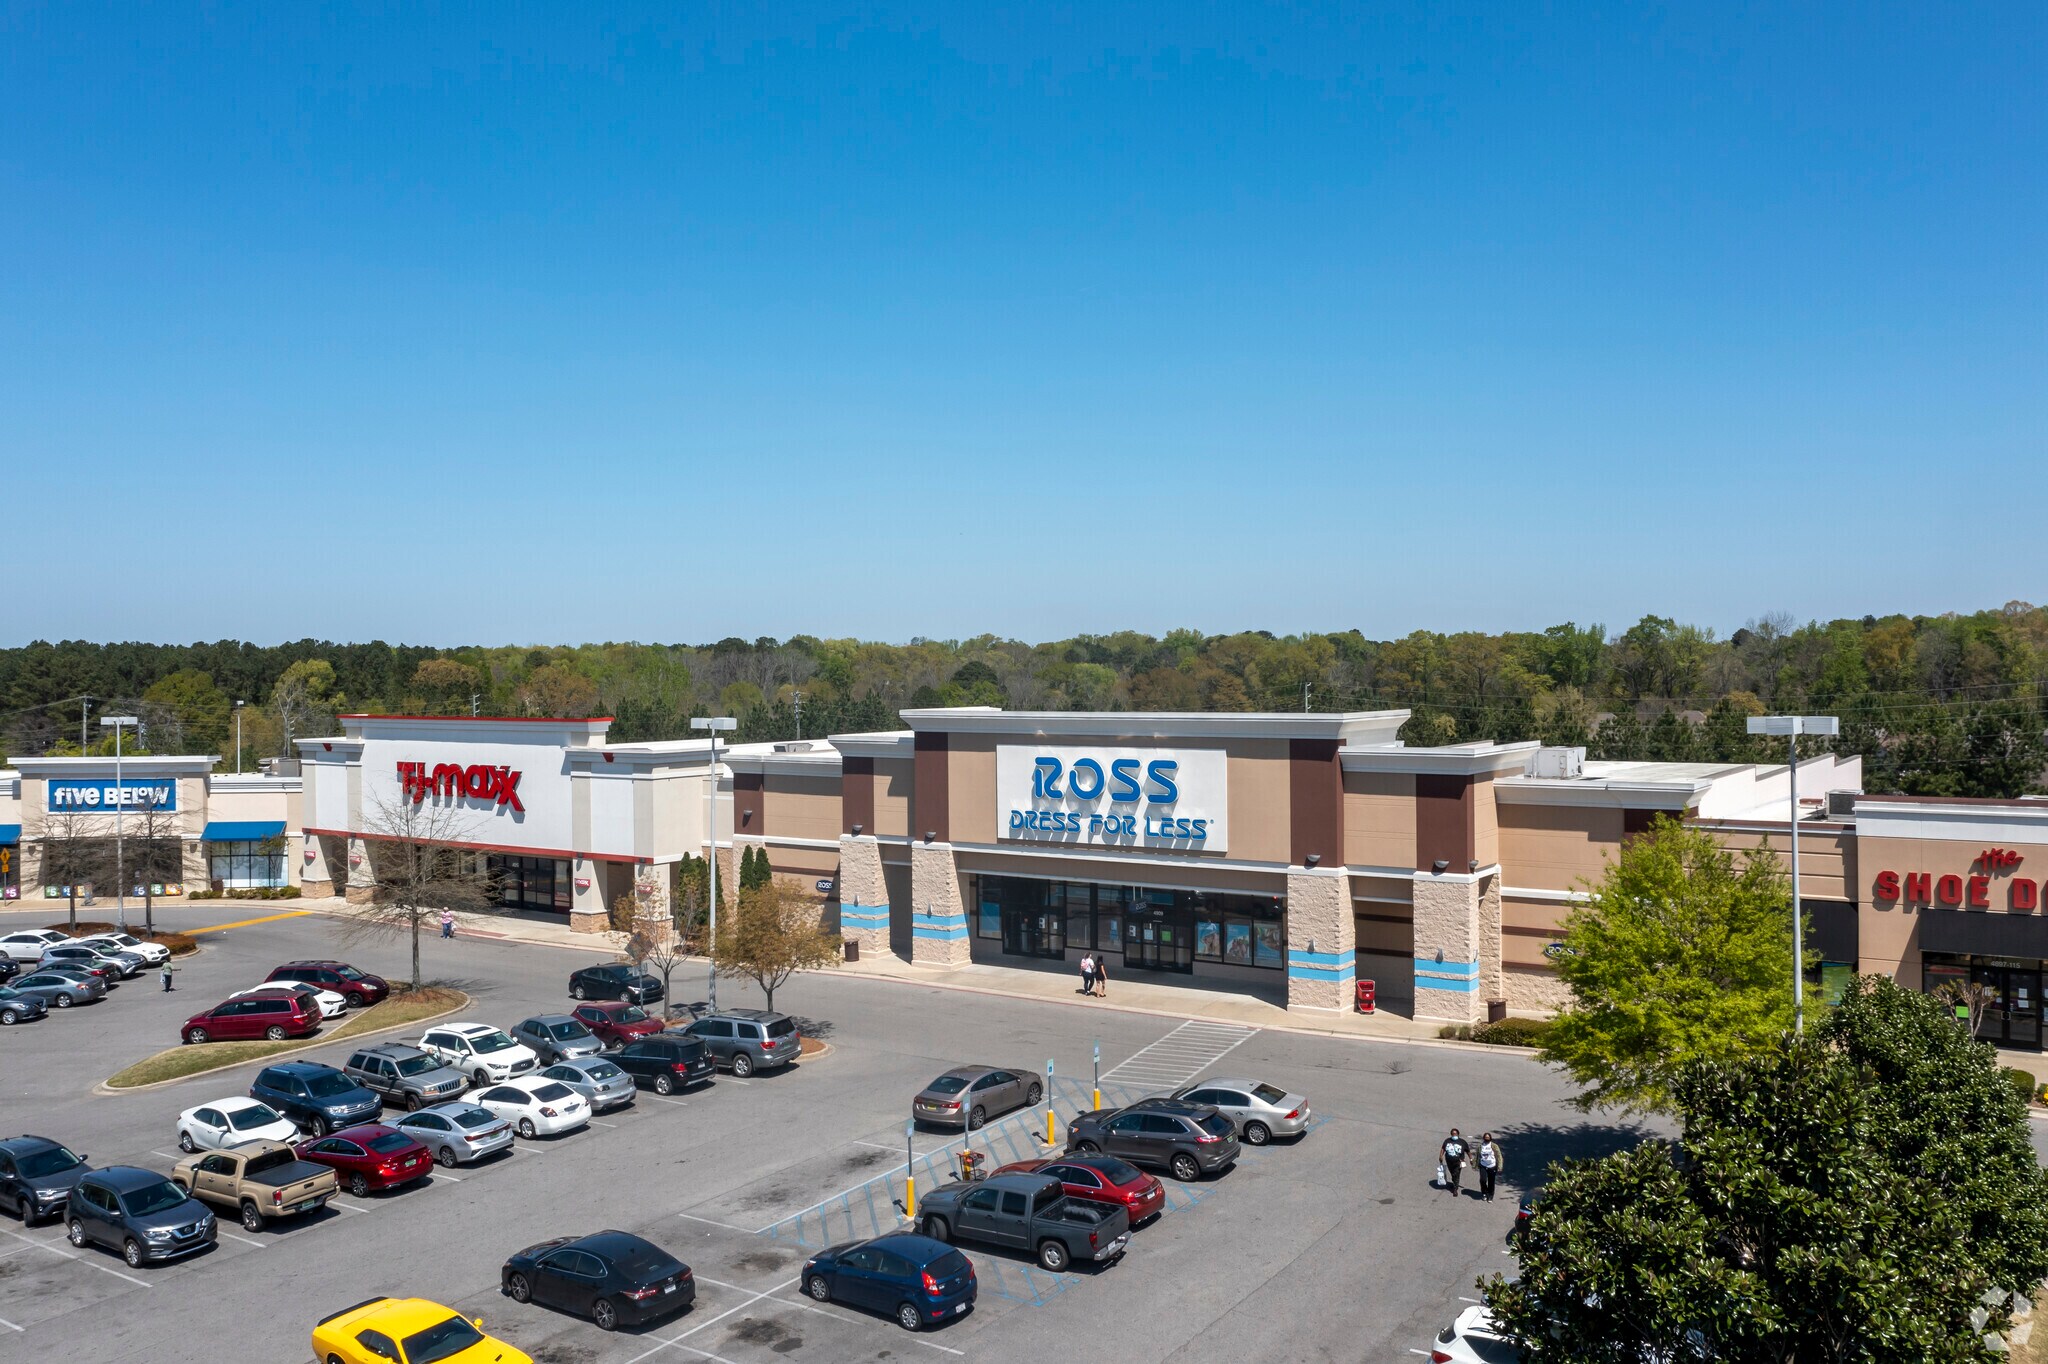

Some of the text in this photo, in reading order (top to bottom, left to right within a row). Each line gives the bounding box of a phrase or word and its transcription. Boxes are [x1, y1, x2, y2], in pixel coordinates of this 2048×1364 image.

[1034, 756, 1179, 804] ROSS
[1010, 810, 1208, 840] DRESS FOR LESS
[1974, 847, 2025, 873] the
[817, 881, 833, 889] ROSS
[1877, 870, 2048, 911] SHOE D
[1548, 946, 1575, 955] ROS
